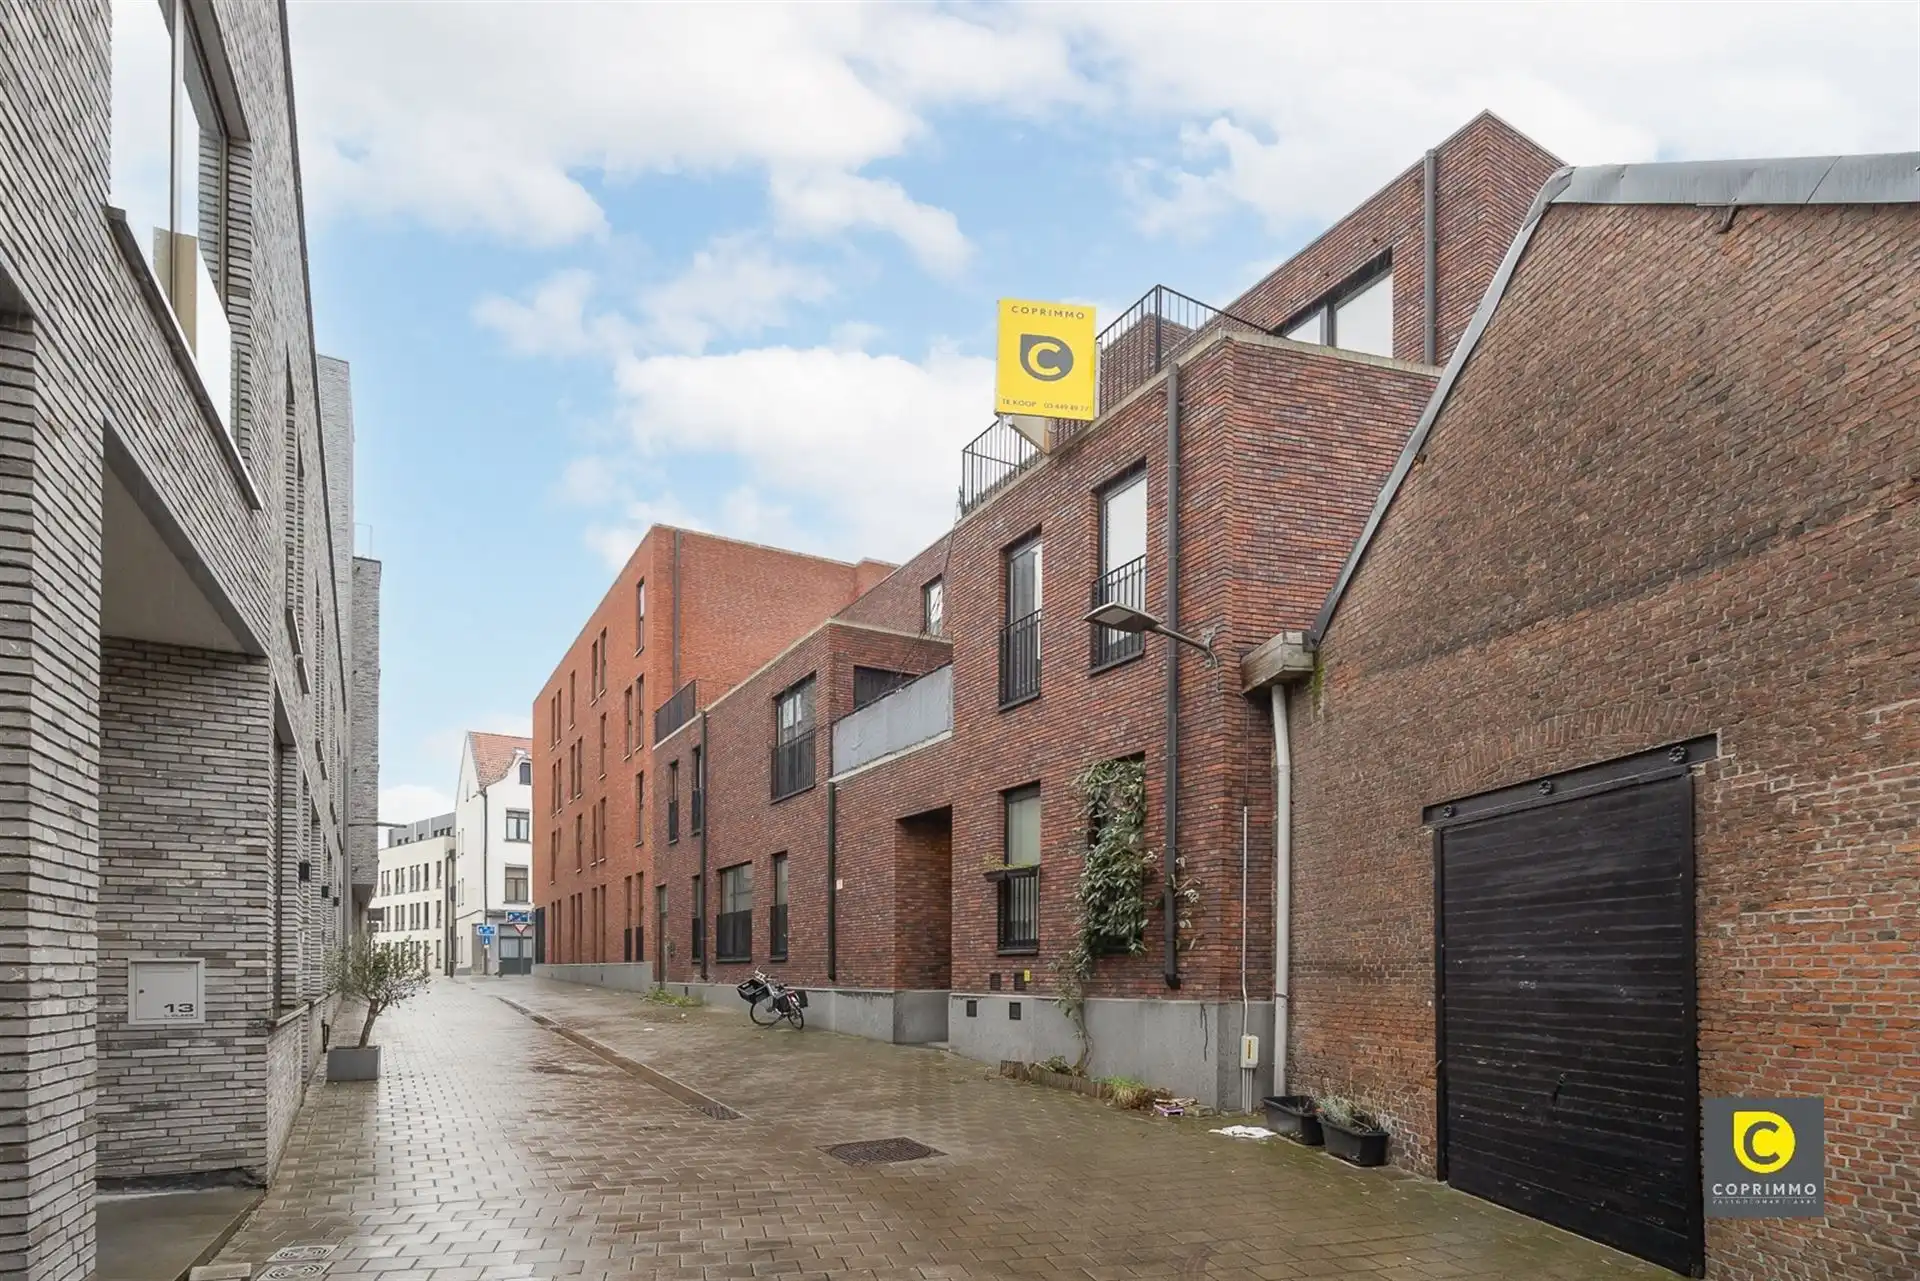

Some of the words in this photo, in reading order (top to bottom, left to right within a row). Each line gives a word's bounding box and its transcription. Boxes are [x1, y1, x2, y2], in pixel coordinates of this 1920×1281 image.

[1011, 305, 1085, 320] COPRIMMO
[1028, 342, 1061, 376] C
[1013, 399, 1037, 407] KOOP
[163, 1003, 194, 1013] 13
